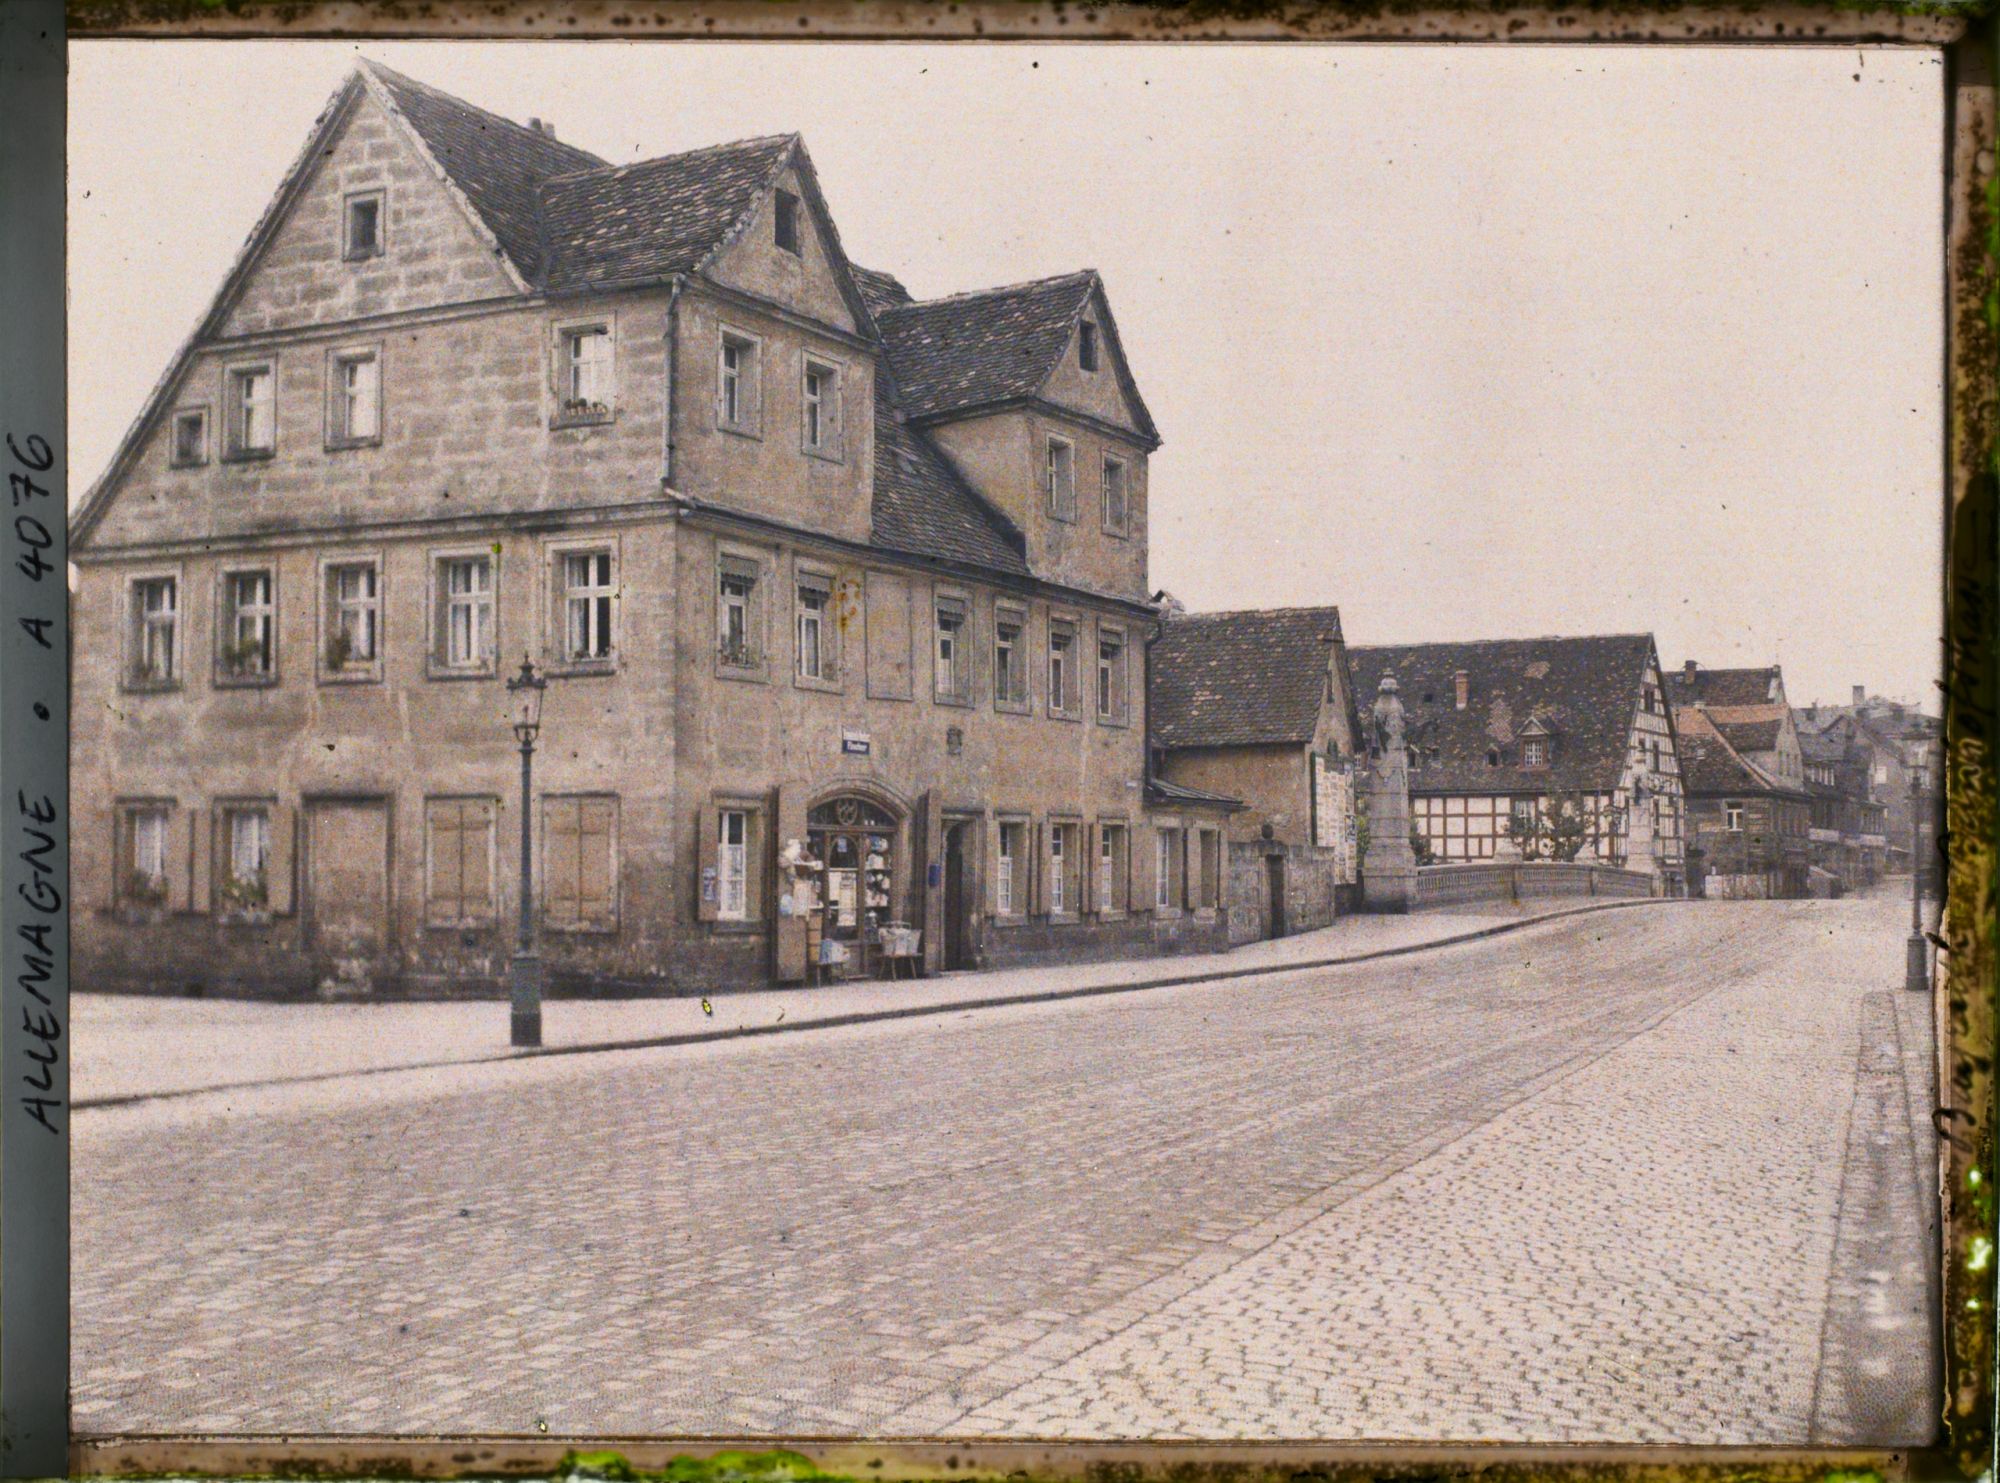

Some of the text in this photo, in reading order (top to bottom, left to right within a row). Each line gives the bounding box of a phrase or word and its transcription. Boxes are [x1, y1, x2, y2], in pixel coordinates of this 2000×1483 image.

[7, 432, 62, 1136] ALLEMAGNE A 4076
